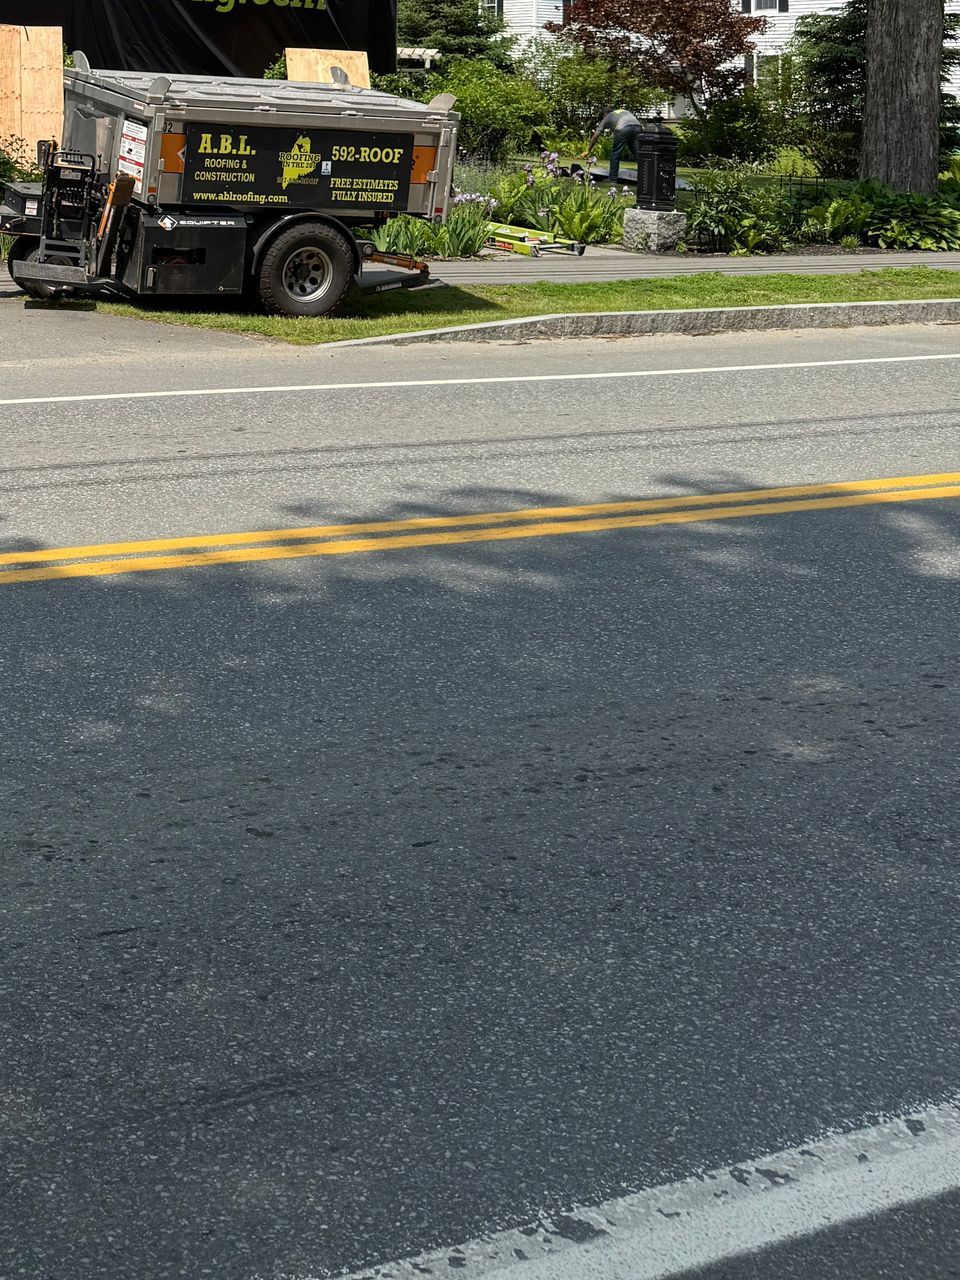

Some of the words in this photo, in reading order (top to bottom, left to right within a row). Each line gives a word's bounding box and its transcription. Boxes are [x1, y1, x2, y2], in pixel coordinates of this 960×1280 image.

[198, 133, 257, 155] A.B.L.
[279, 151, 322, 163] ROOFING
[331, 145, 404, 164] 592-ROOF
[204, 158, 240, 169] ROOFING
[241, 160, 248, 169] &
[194, 171, 255, 183] CONSTRUCTION
[330, 177, 352, 189] FREE
[352, 178, 399, 191] ESTIMATES
[192, 191, 289, 205] www.ablroofing.com
[331, 190, 356, 202] FULLY
[358, 191, 395, 203] INSURED
